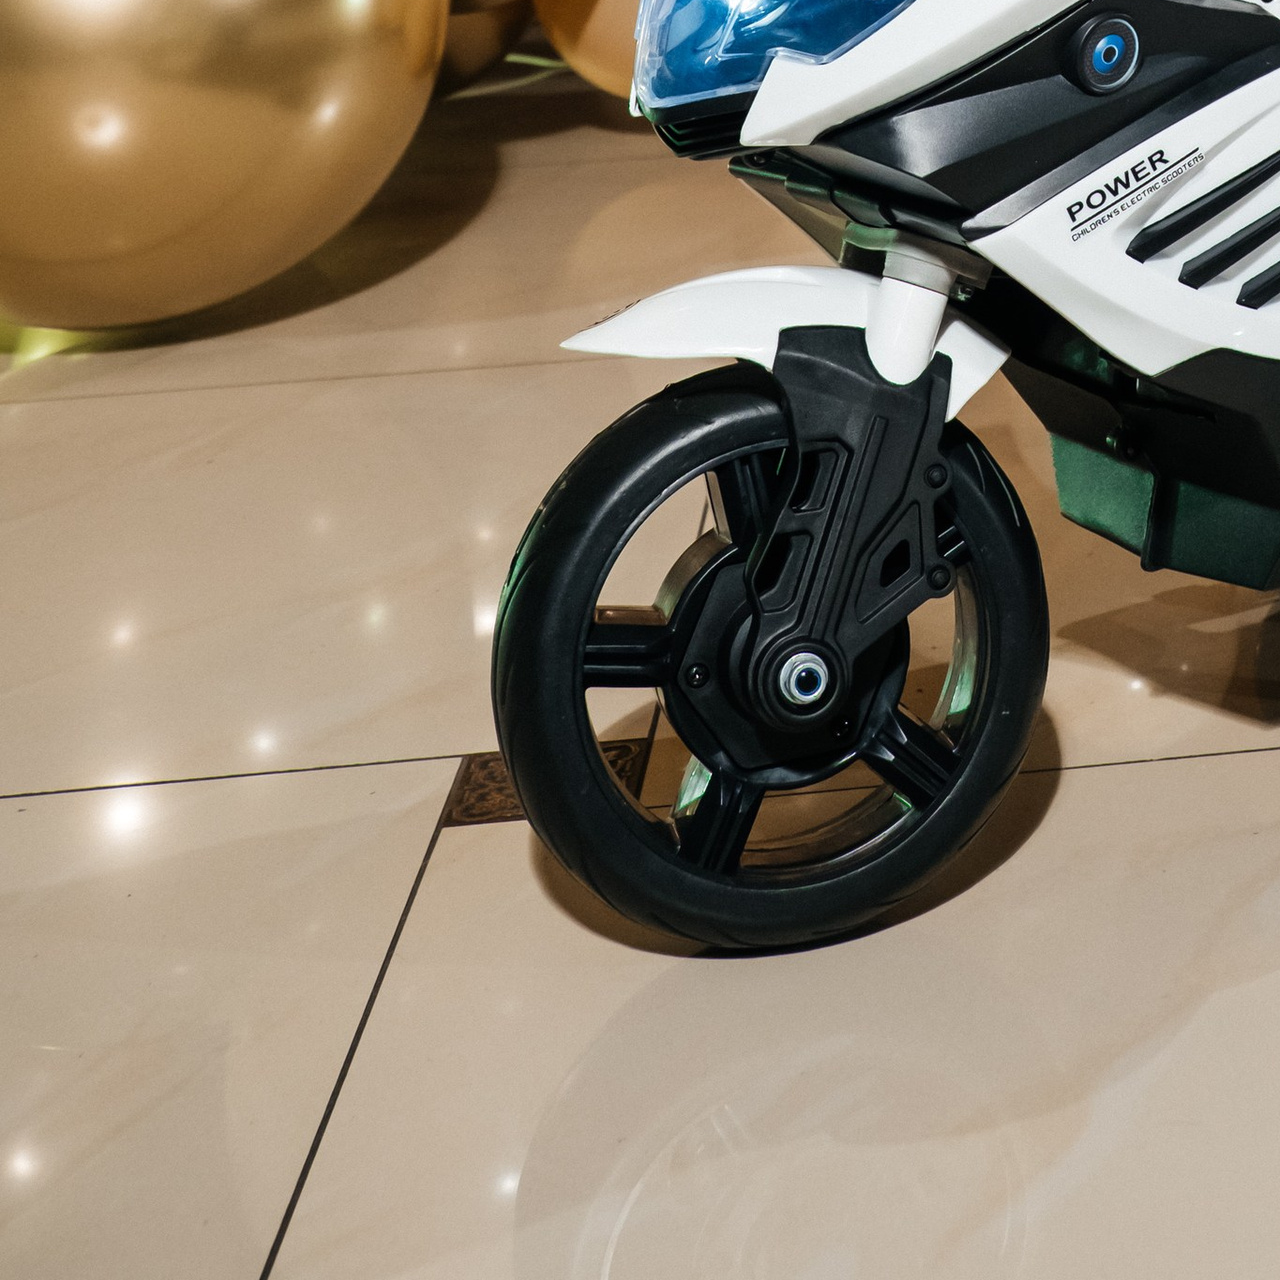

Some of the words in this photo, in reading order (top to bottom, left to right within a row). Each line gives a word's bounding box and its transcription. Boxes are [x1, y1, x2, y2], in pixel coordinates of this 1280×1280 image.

[1066, 149, 1170, 223] POWER
[1071, 209, 1121, 242] CHILDREN'S
[1120, 182, 1161, 212] ELECTRIC
[1161, 152, 1205, 186] SCOOTERS
